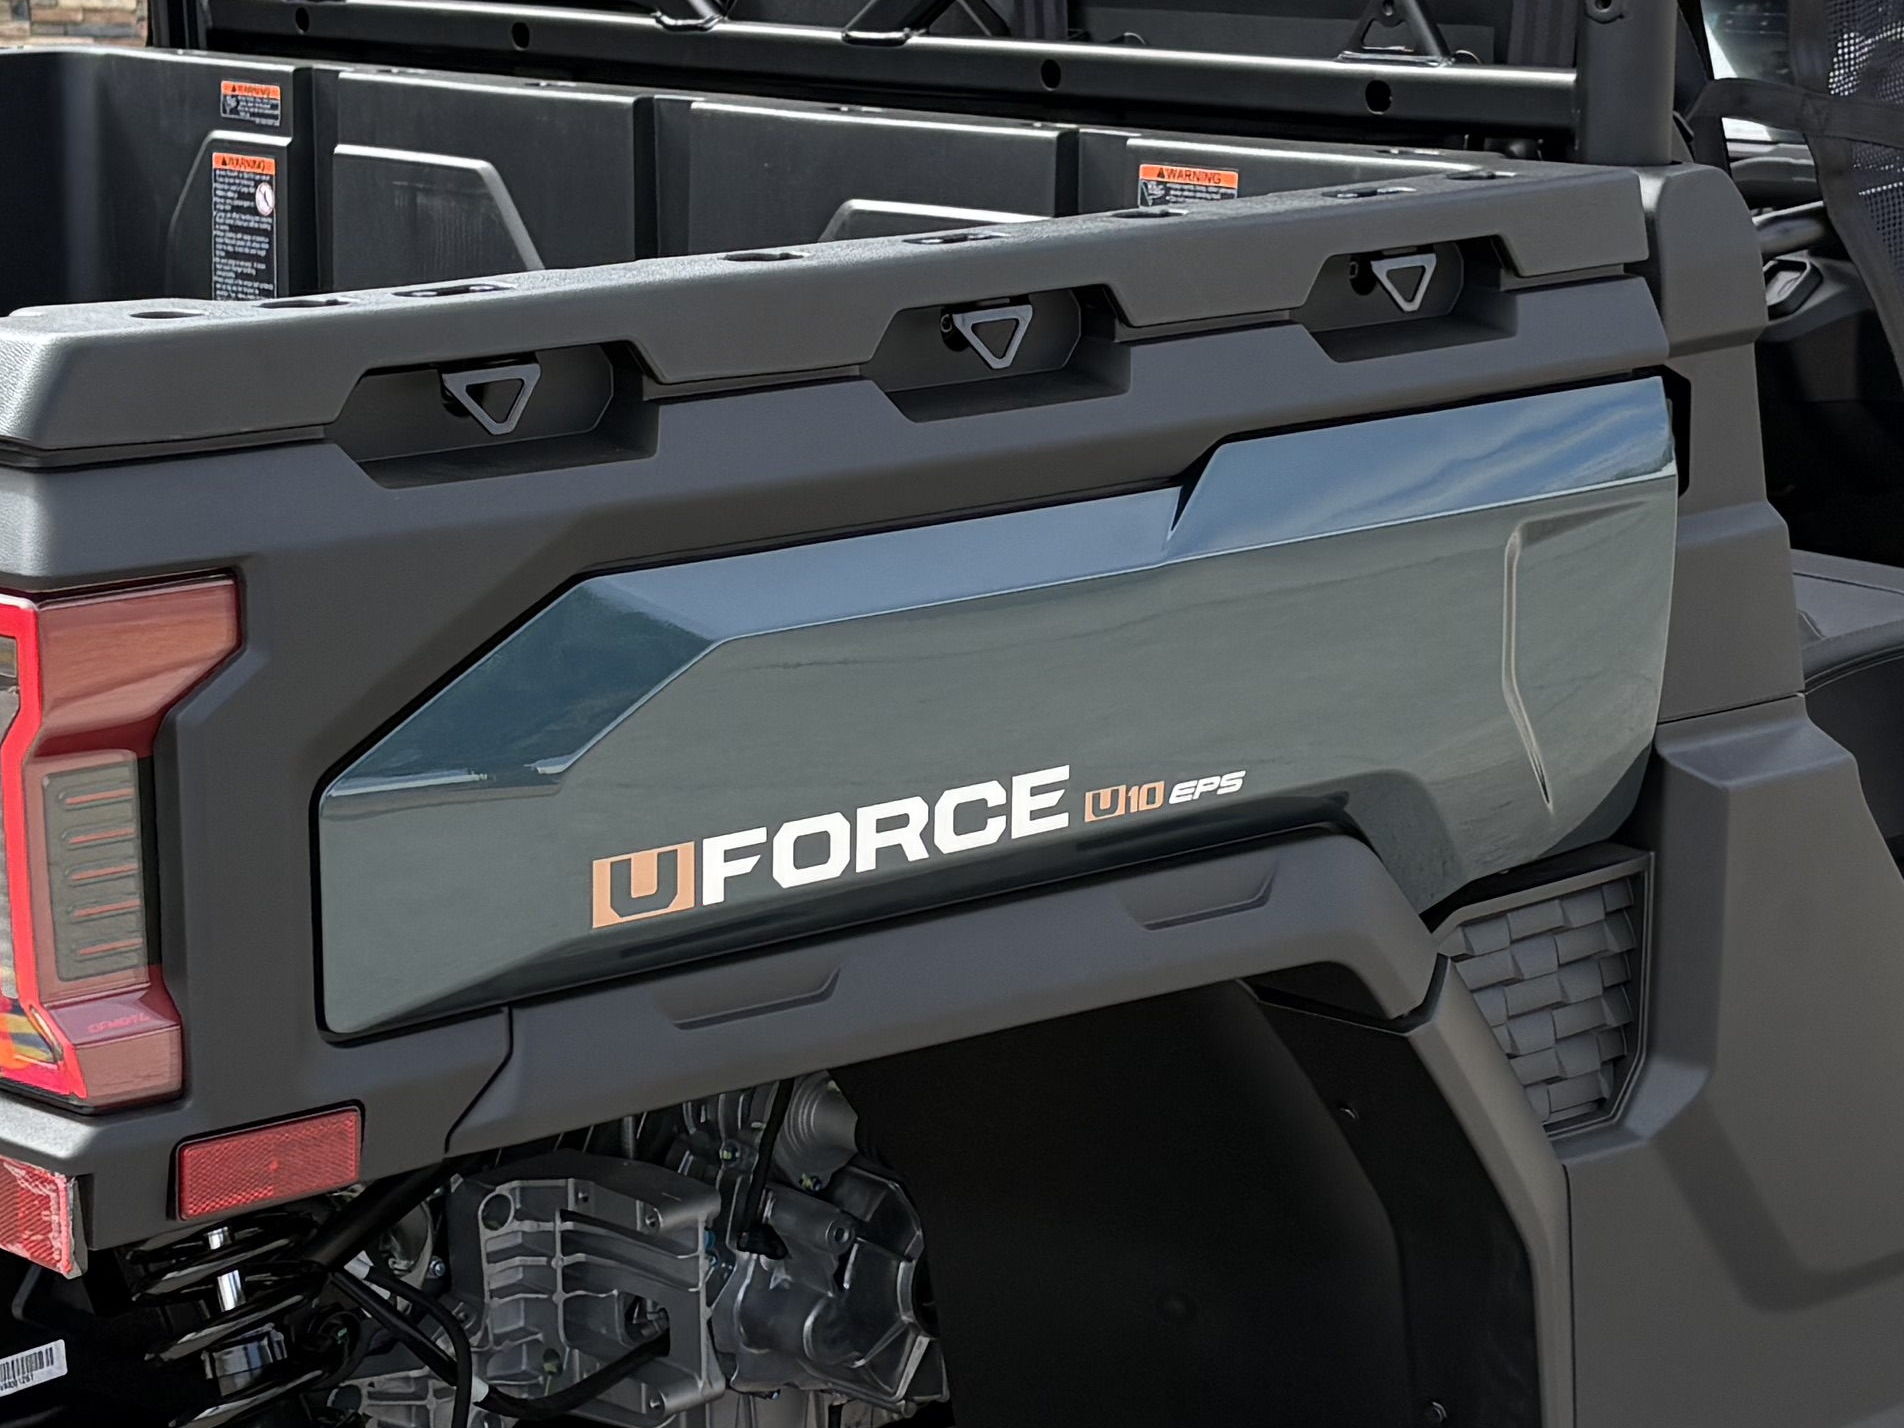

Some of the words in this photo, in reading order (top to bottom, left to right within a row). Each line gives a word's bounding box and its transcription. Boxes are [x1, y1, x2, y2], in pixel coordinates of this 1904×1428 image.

[1167, 169, 1222, 183] WARNING
[1085, 781, 1165, 823] U10
[1169, 770, 1246, 804] EPS
